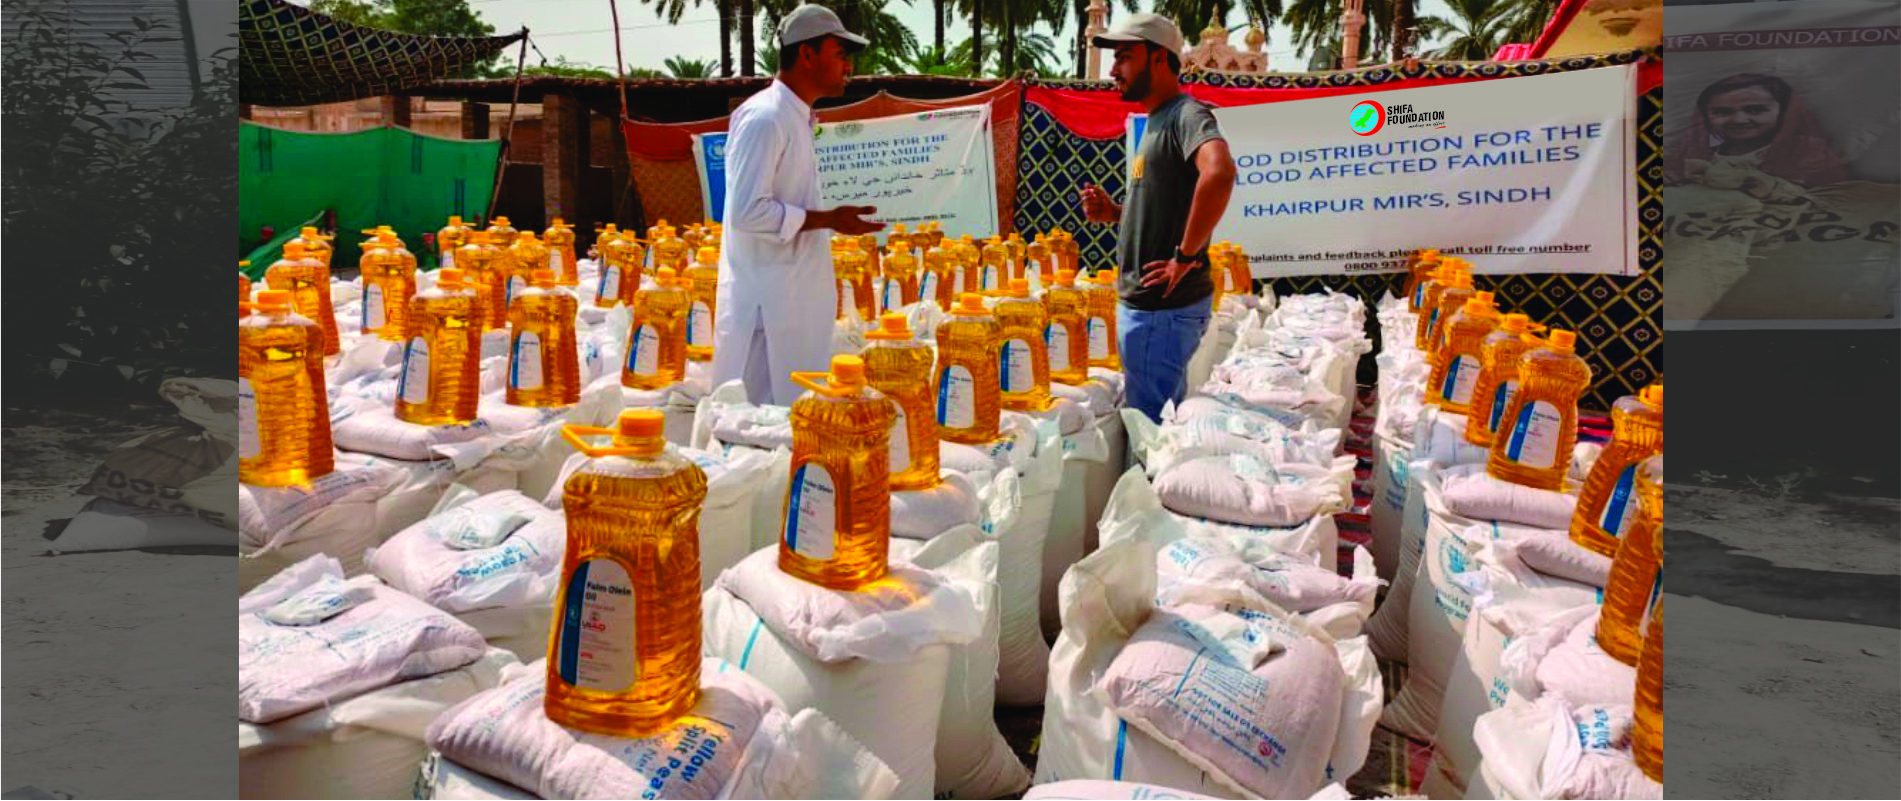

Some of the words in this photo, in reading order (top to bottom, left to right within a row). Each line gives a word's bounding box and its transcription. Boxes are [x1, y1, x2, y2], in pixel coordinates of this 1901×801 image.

[1718, 28, 1900, 47] FOUNDATION
[893, 137, 920, 146] FOR
[923, 134, 946, 142] THE
[1233, 154, 1272, 168] OD
[1280, 135, 1462, 165] DISTRIBUTION
[1474, 130, 1531, 148] FOR
[1541, 123, 1602, 141] THE
[819, 151, 879, 163] AFFECTED
[881, 145, 941, 157] FAMILIES
[890, 155, 930, 166] SINDH
[1309, 158, 1437, 180] AFFECTED
[1448, 146, 1580, 169] FAMILIES
[1244, 198, 1364, 217] KHAIRPUR
[1374, 193, 1449, 210] MIR'S,
[1457, 186, 1551, 205] SINDH
[1299, 252, 1322, 261] and
[1325, 249, 1385, 261] feedback
[1440, 245, 1465, 254] call
[1469, 244, 1492, 254] toll
[1497, 244, 1525, 253] free
[1529, 242, 1592, 253] number
[1344, 262, 1378, 271] 0800
[674, 725, 707, 755] Split
[681, 733, 723, 783] Yellow
[642, 756, 682, 801] Peas
